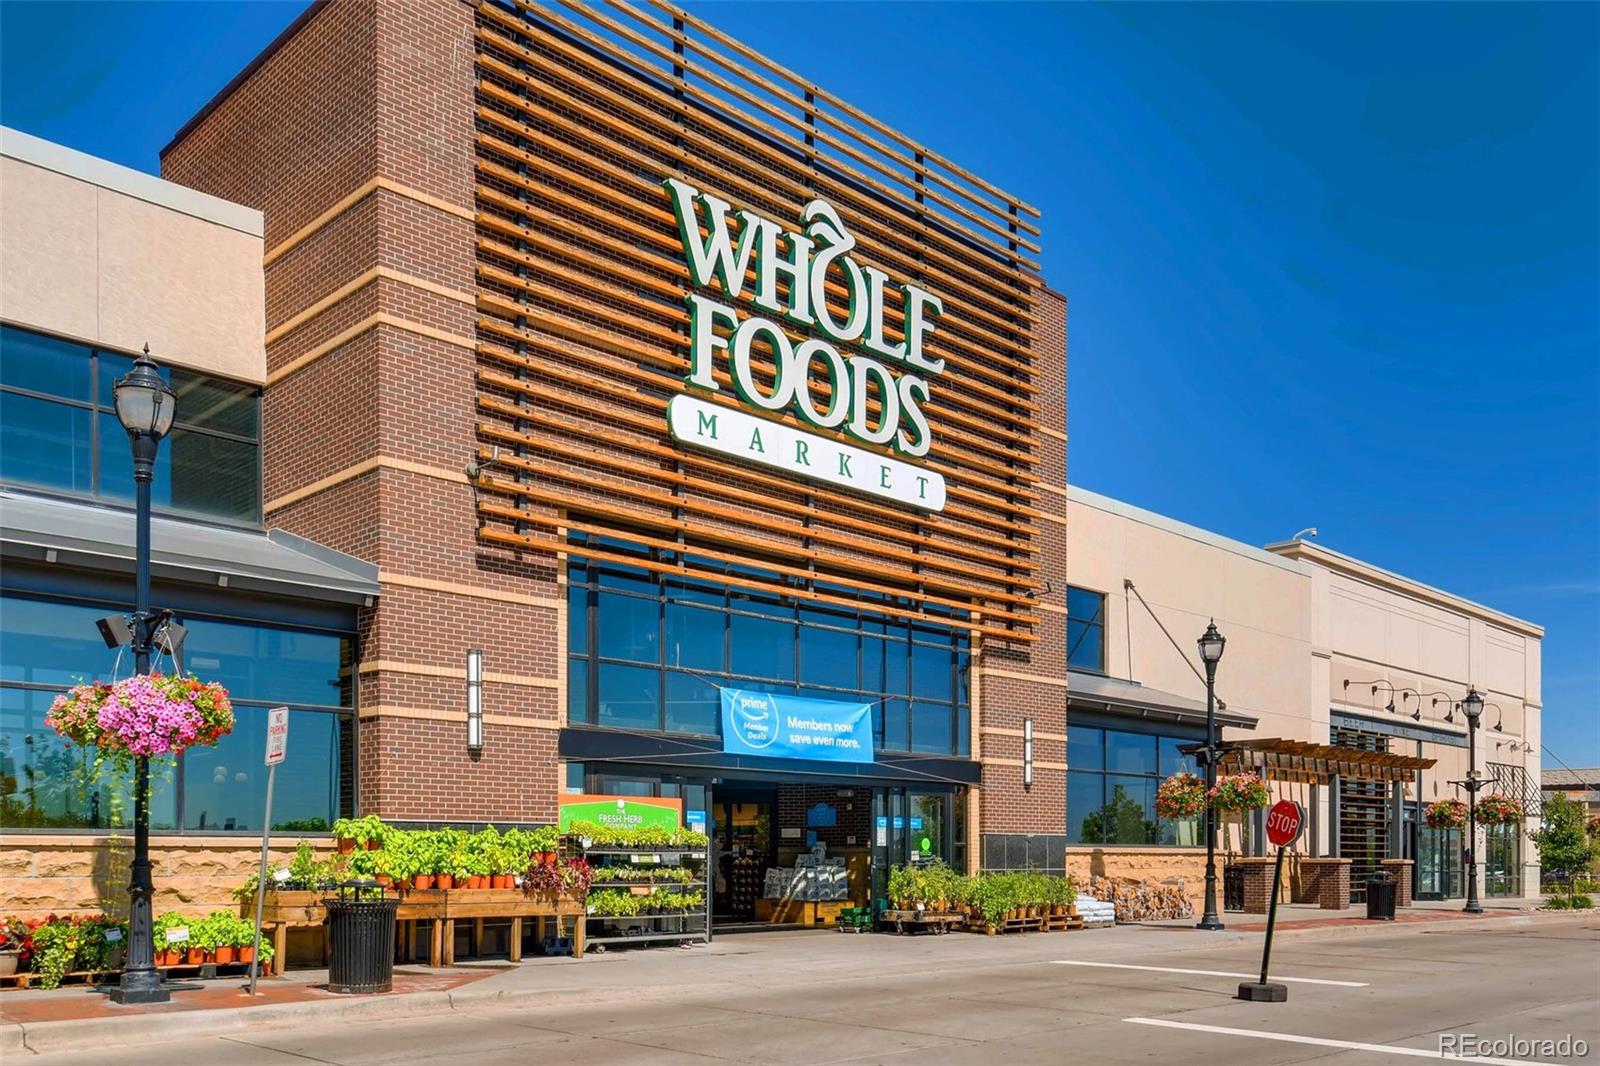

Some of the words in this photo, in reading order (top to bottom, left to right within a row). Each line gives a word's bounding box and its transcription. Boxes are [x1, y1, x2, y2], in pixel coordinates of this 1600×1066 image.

[661, 178, 945, 374] WHOLE
[685, 294, 931, 457] FOODS
[697, 410, 928, 499] MARKET
[741, 697, 768, 711] prime
[743, 722, 769, 732] Member
[787, 716, 833, 732] Members
[834, 723, 854, 733] now
[747, 731, 767, 740] Deals
[789, 735, 812, 745] save
[813, 736, 834, 746] even
[835, 738, 861, 748] more.
[598, 814, 622, 824] FRESH
[623, 815, 643, 824] HERB
[1267, 811, 1298, 835] STOP
